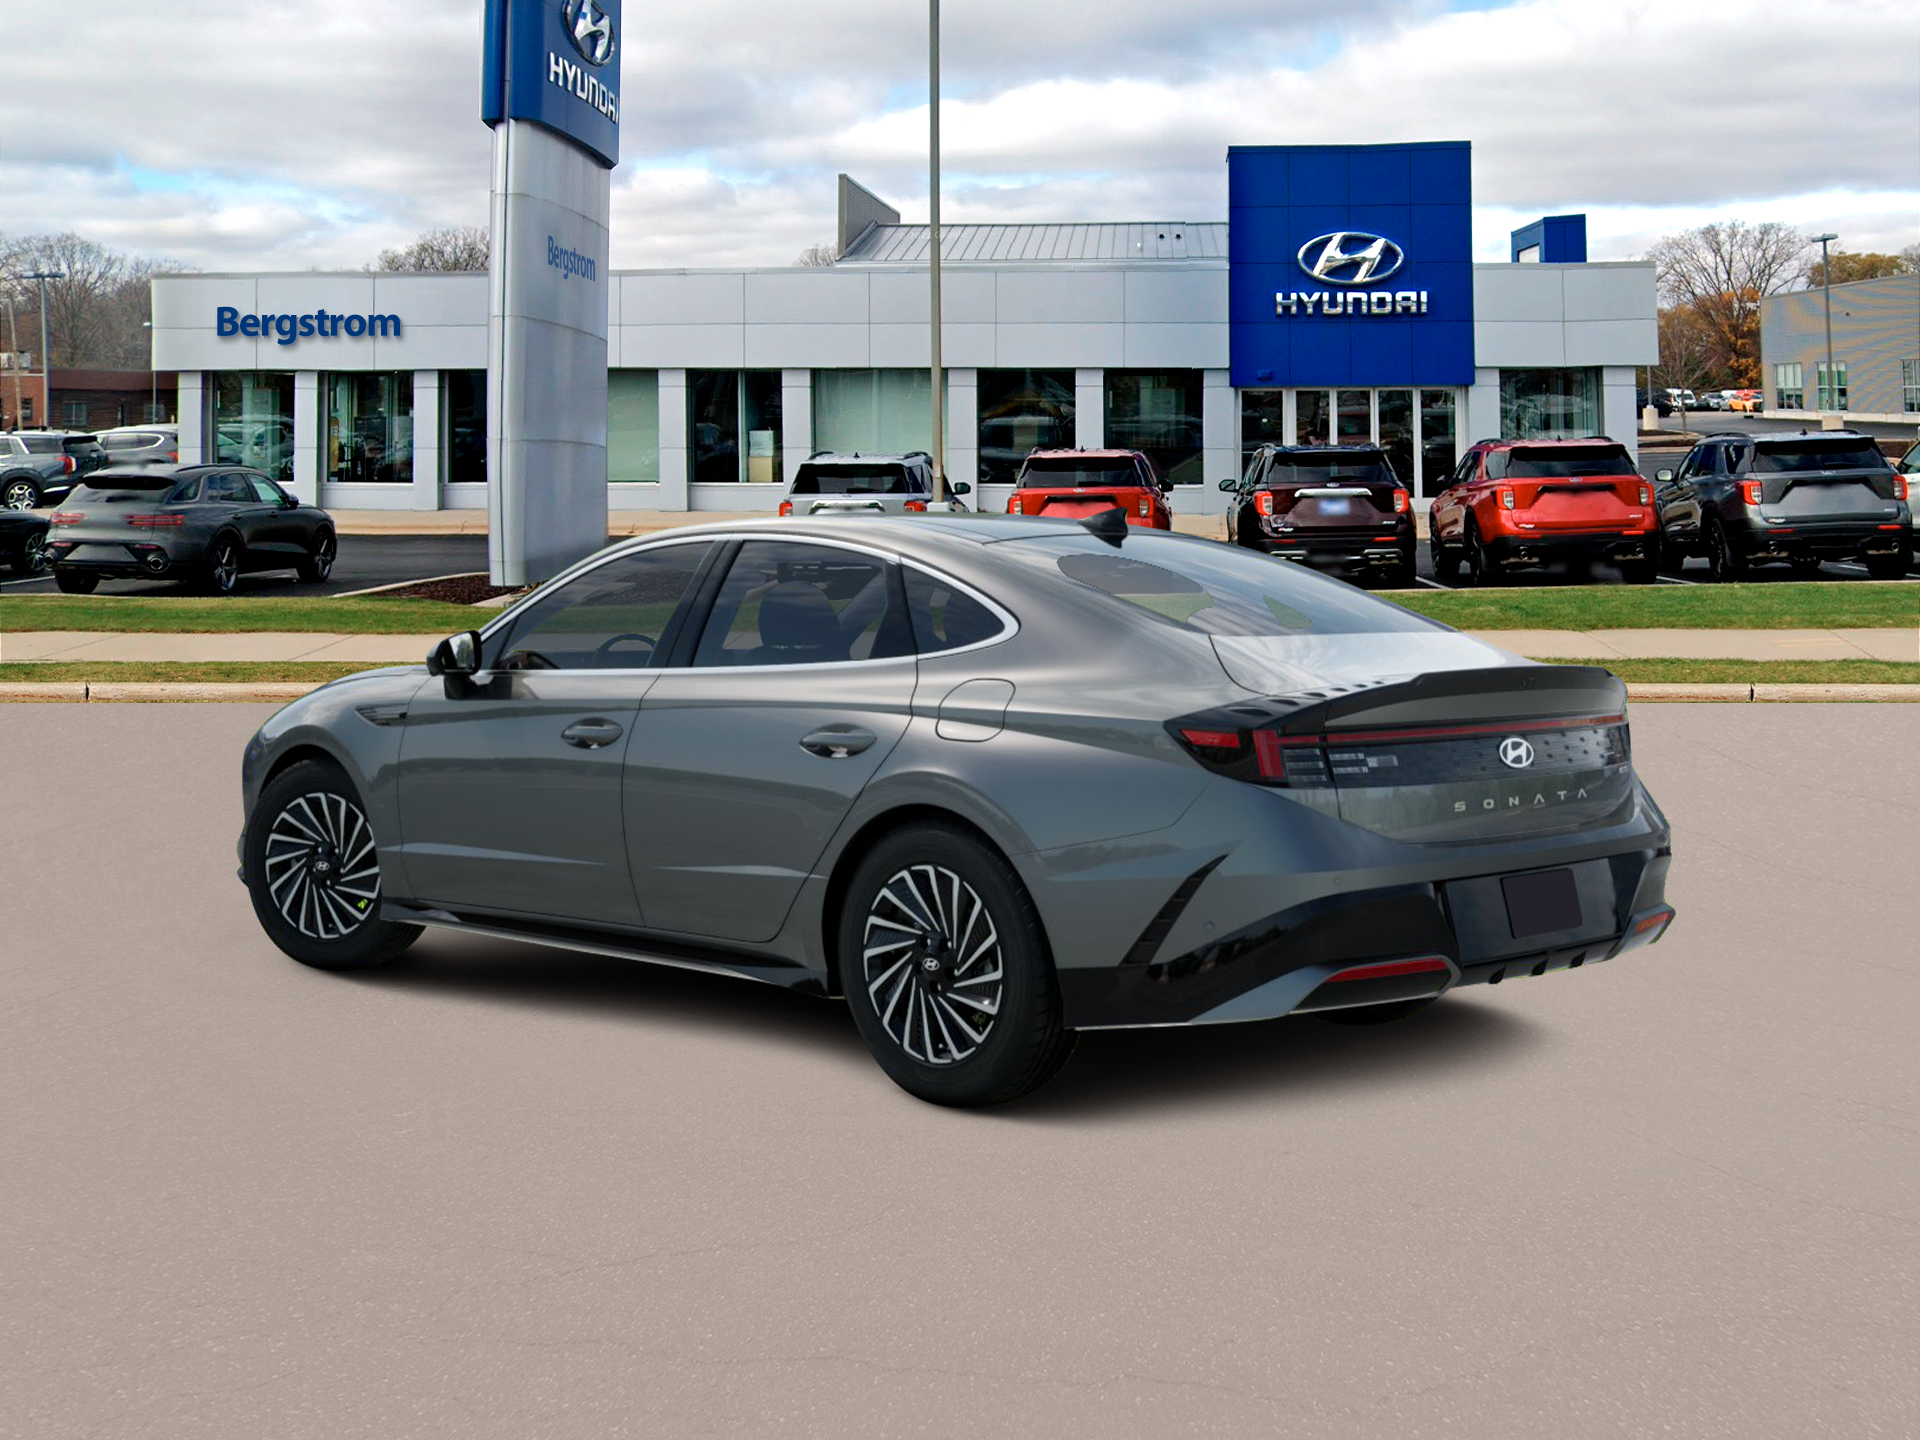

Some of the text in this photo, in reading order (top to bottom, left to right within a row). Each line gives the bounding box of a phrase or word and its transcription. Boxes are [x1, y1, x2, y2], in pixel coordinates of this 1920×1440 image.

[549, 52, 618, 124] HYUNDAI
[548, 235, 595, 282] Bergstrom
[1276, 291, 1427, 314] HYUNDAI
[217, 306, 401, 345] Bergstrom
[1454, 788, 1587, 812] SONATA
